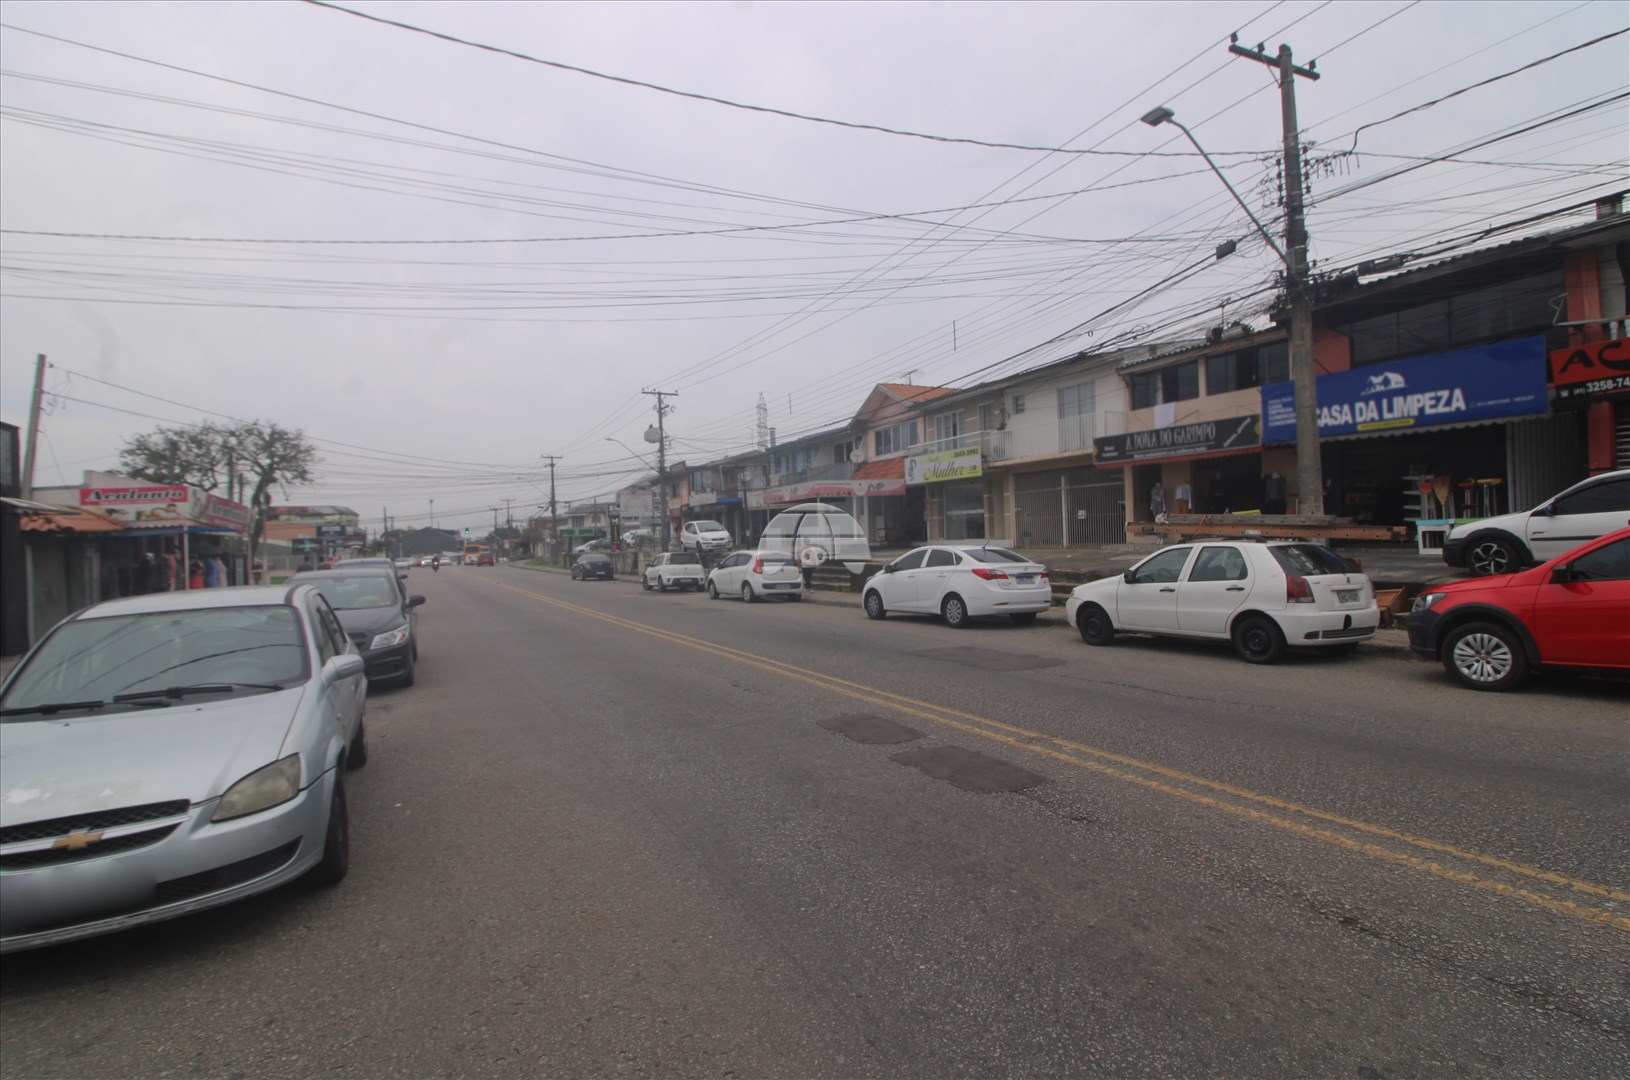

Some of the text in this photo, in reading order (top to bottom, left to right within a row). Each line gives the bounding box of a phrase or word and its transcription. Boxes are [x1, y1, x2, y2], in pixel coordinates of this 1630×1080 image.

[1355, 400, 1380, 423] DA
[1382, 387, 1466, 420] LIMPEZA
[1126, 436, 1133, 450] A
[1133, 432, 1158, 449] DONA
[1160, 428, 1172, 446] DO
[1174, 423, 1216, 444] GARIMPO
[923, 461, 964, 480] Mulher
